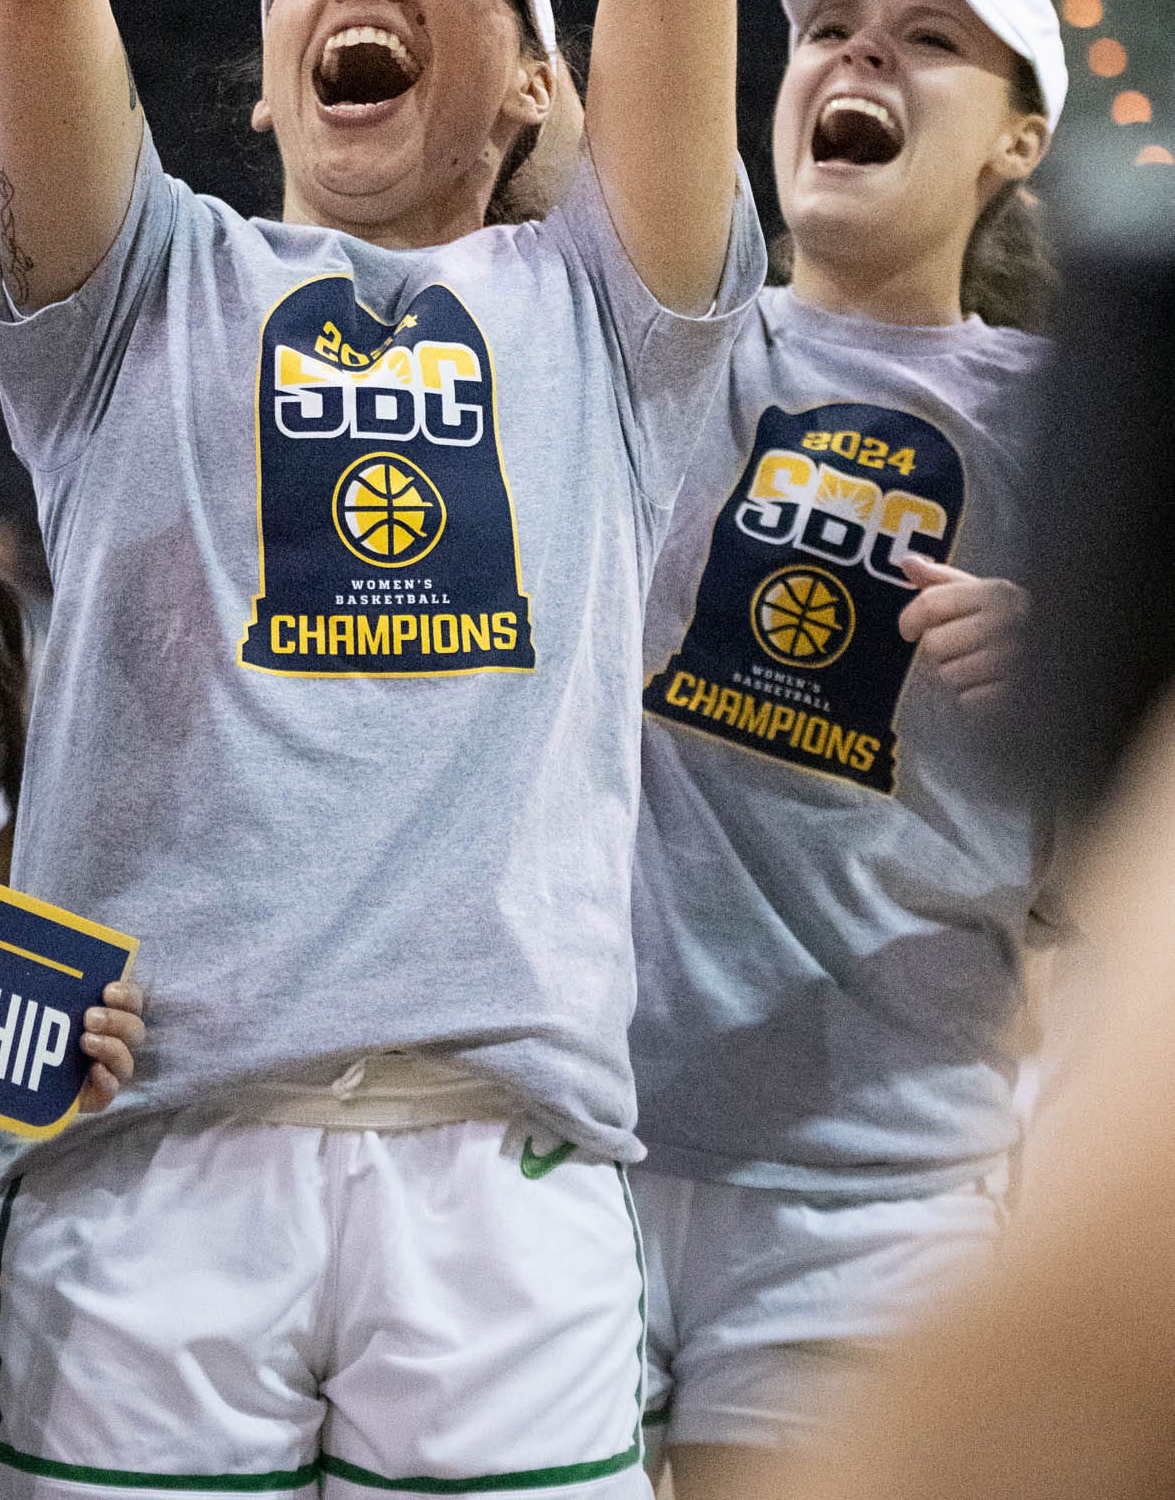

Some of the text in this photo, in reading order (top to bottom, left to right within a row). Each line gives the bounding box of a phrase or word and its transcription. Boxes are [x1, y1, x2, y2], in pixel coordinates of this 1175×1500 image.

[274, 340, 484, 448] SBC
[802, 430, 917, 476] 2024
[735, 448, 948, 590] SBC
[335, 593, 451, 606] BASKETBALL
[351, 579, 433, 591] WOMEN'S
[270, 611, 518, 656] CHAMPIONS
[666, 671, 881, 774] CHAMPIONS
